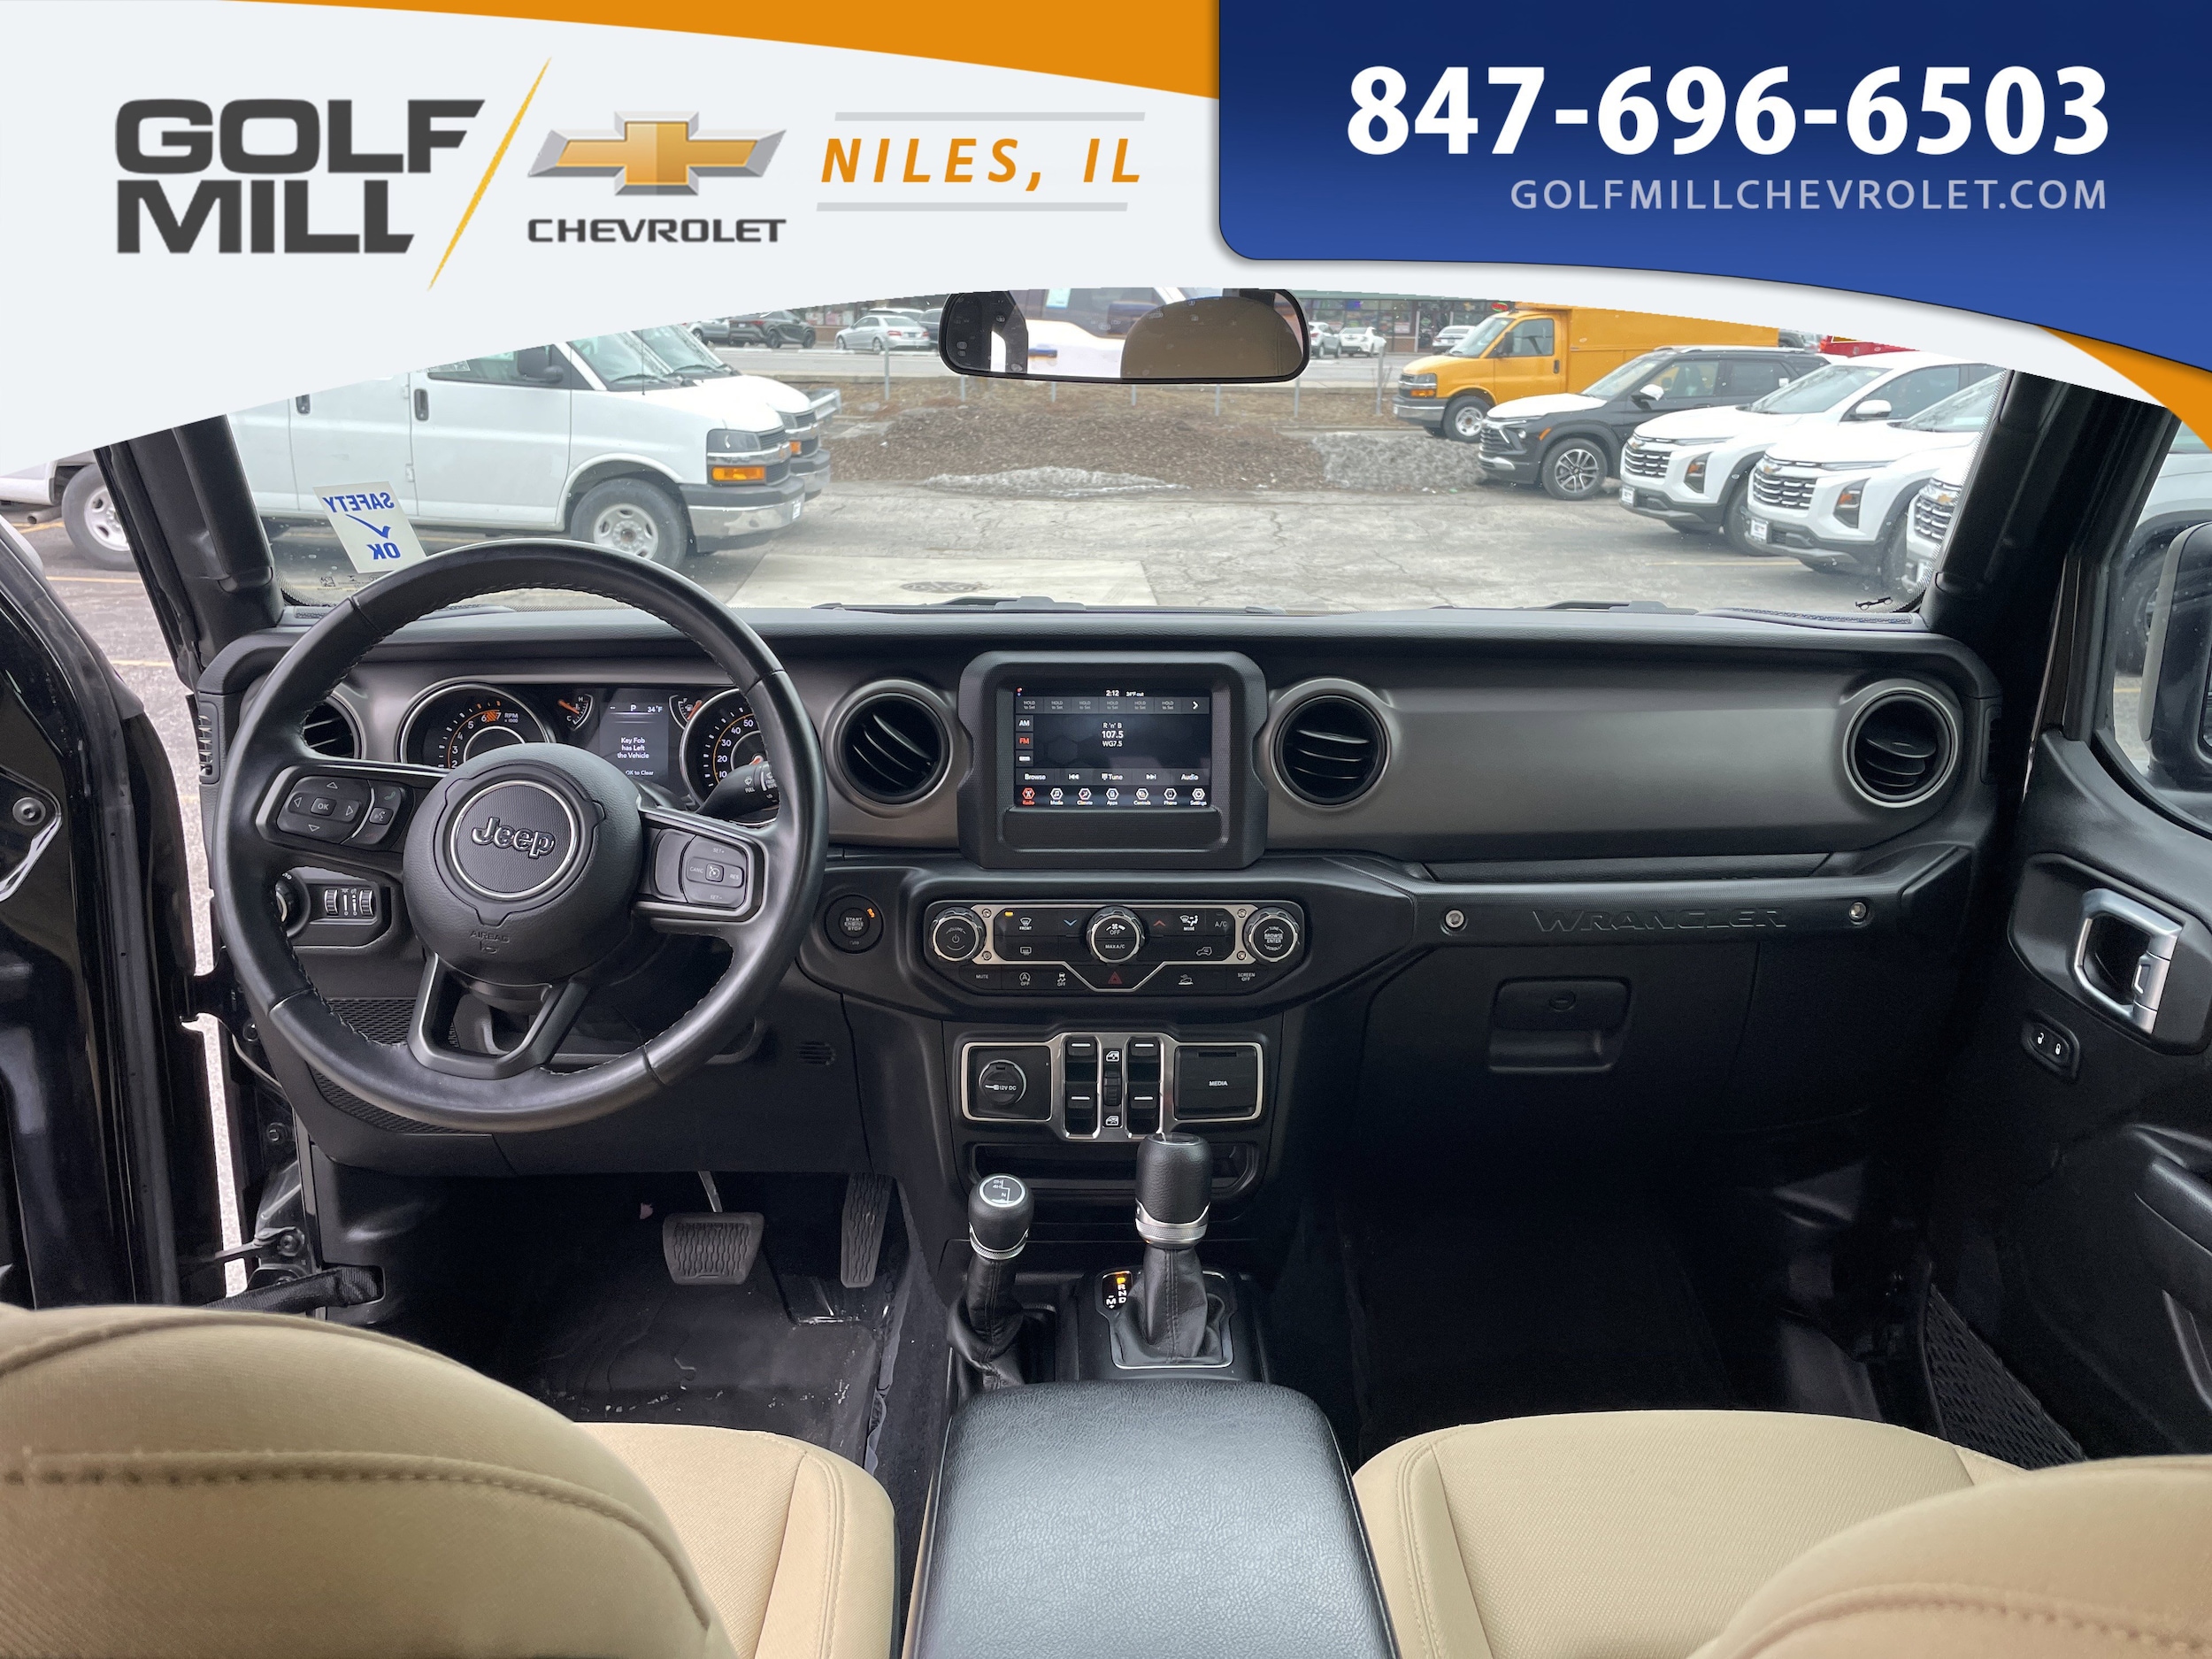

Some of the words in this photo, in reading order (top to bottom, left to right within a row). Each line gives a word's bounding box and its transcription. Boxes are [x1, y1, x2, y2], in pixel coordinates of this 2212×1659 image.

[318, 802, 329, 810] OK
[472, 817, 556, 859] Jeep
[1532, 907, 1787, 931] WRANGLER
[470, 931, 511, 943] AIRBAG
